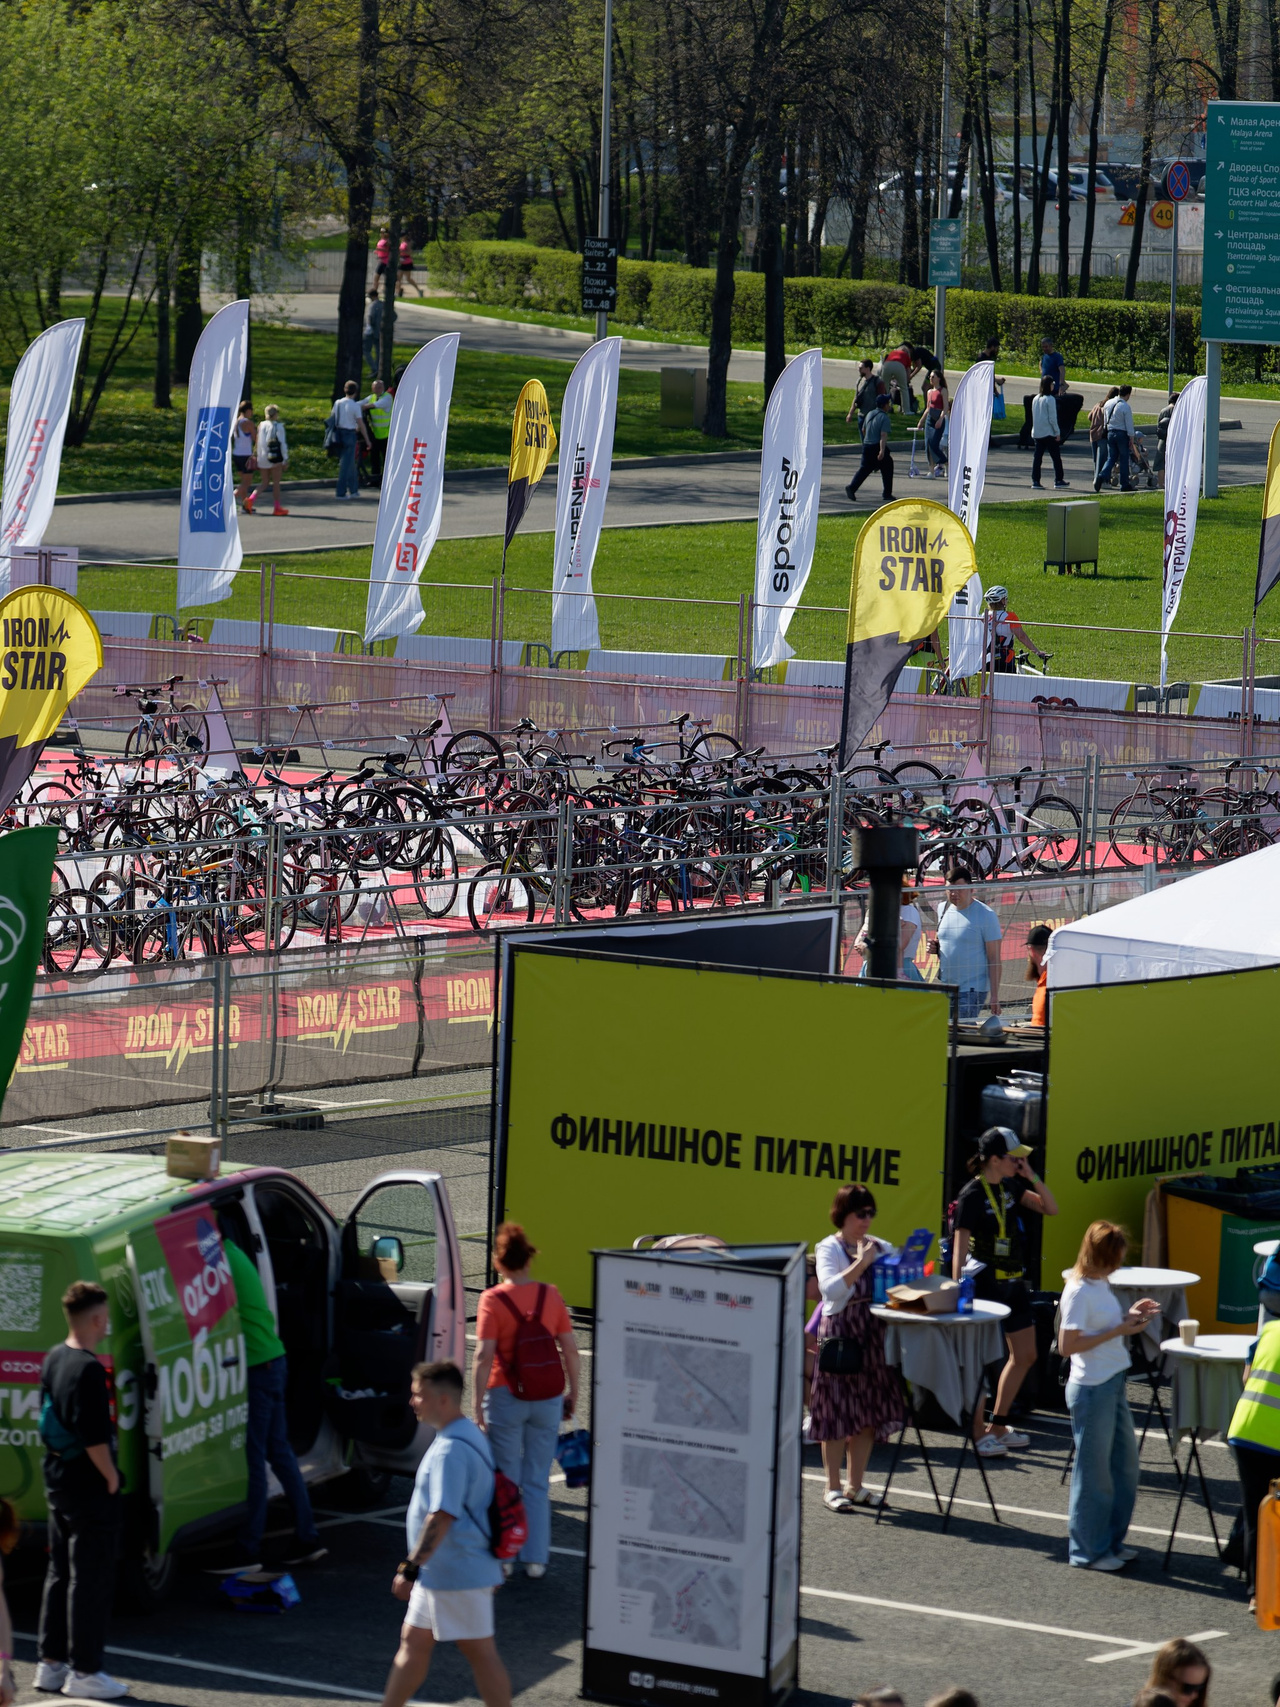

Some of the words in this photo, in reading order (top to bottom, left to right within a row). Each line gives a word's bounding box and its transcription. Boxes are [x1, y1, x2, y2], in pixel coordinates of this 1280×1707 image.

[1230, 117, 1257, 127] Малая
[1230, 129, 1253, 138] Malaya
[1254, 130, 1273, 138] Arena
[1228, 163, 1262, 173] Дворец
[1228, 174, 1249, 183] Palace
[1250, 175, 1258, 184] of
[1259, 175, 1277, 185] Sport
[1228, 187, 1250, 197] ГЦКЗ
[1228, 198, 1253, 207] Concert
[1254, 199, 1267, 208] Hall
[1155, 208, 1173, 222] 40
[584, 239, 608, 248] Ложи
[584, 248, 605, 257] Suites
[1227, 242, 1266, 251] площадь
[1226, 252, 1267, 262] Tsentralnaya
[583, 276, 607, 286] Ложи
[583, 286, 604, 295] Suites
[1225, 296, 1264, 306] площадь
[1225, 306, 1263, 317] Festivalnaya
[524, 421, 548, 449] STAR
[193, 418, 209, 520] STELLAR
[209, 419, 225, 519] AQUA
[405, 437, 428, 534] МАГНИТ
[959, 464, 972, 521] STAR
[880, 525, 928, 554] IRON
[879, 554, 945, 594] STAR
[3, 616, 51, 649] IRON
[0, 649, 67, 692] STAR
[447, 977, 491, 1012] IRON
[297, 994, 338, 1030] IRON
[357, 986, 400, 1022] STAR
[125, 1012, 172, 1048] IRON
[195, 1004, 241, 1042] STAR
[22, 1023, 70, 1062] STAR
[549, 1113, 742, 1170] ФИНИШНОЕ
[754, 1135, 901, 1187] ПИТАНИЕ
[1075, 1130, 1214, 1184] ФИНИШНОЕ
